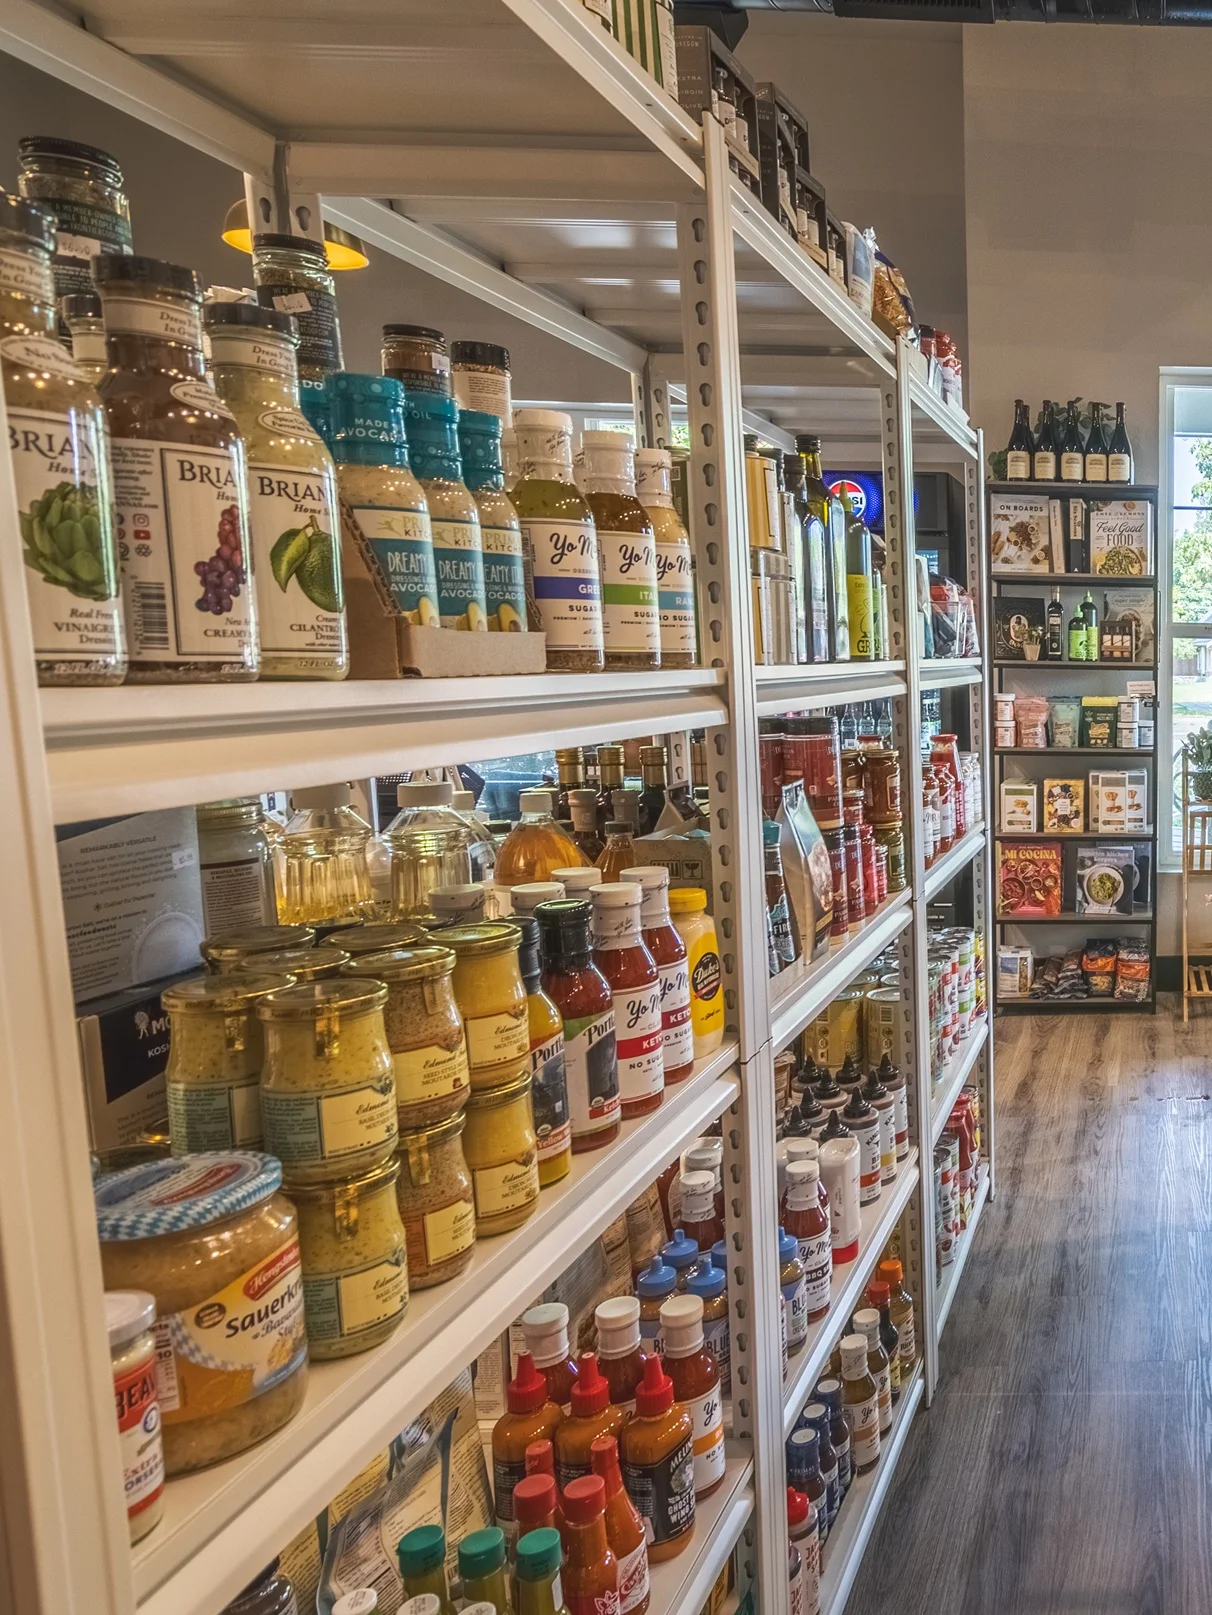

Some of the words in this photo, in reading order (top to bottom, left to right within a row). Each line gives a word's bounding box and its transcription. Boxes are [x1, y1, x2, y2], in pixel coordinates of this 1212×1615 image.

[411, 410, 432, 420] OIL
[354, 417, 390, 430] MADE
[1000, 504, 1011, 512] ON
[1013, 504, 1044, 513] BOARDS
[1096, 521, 1119, 533] Feel
[1118, 521, 1145, 536] Good
[1106, 533, 1134, 547] FOOD
[550, 532, 577, 566] Yo
[387, 551, 427, 574] DREAMY
[619, 544, 643, 574] Yo
[656, 553, 676, 581] Yo
[70, 608, 93, 619] Real
[1005, 849, 1018, 860] MI
[1019, 849, 1057, 861] COCINA
[627, 999, 649, 1029] Yo
[629, 1060, 644, 1070] NO
[800, 1245, 815, 1262] Yo
[157, 1350, 172, 1361] 10
